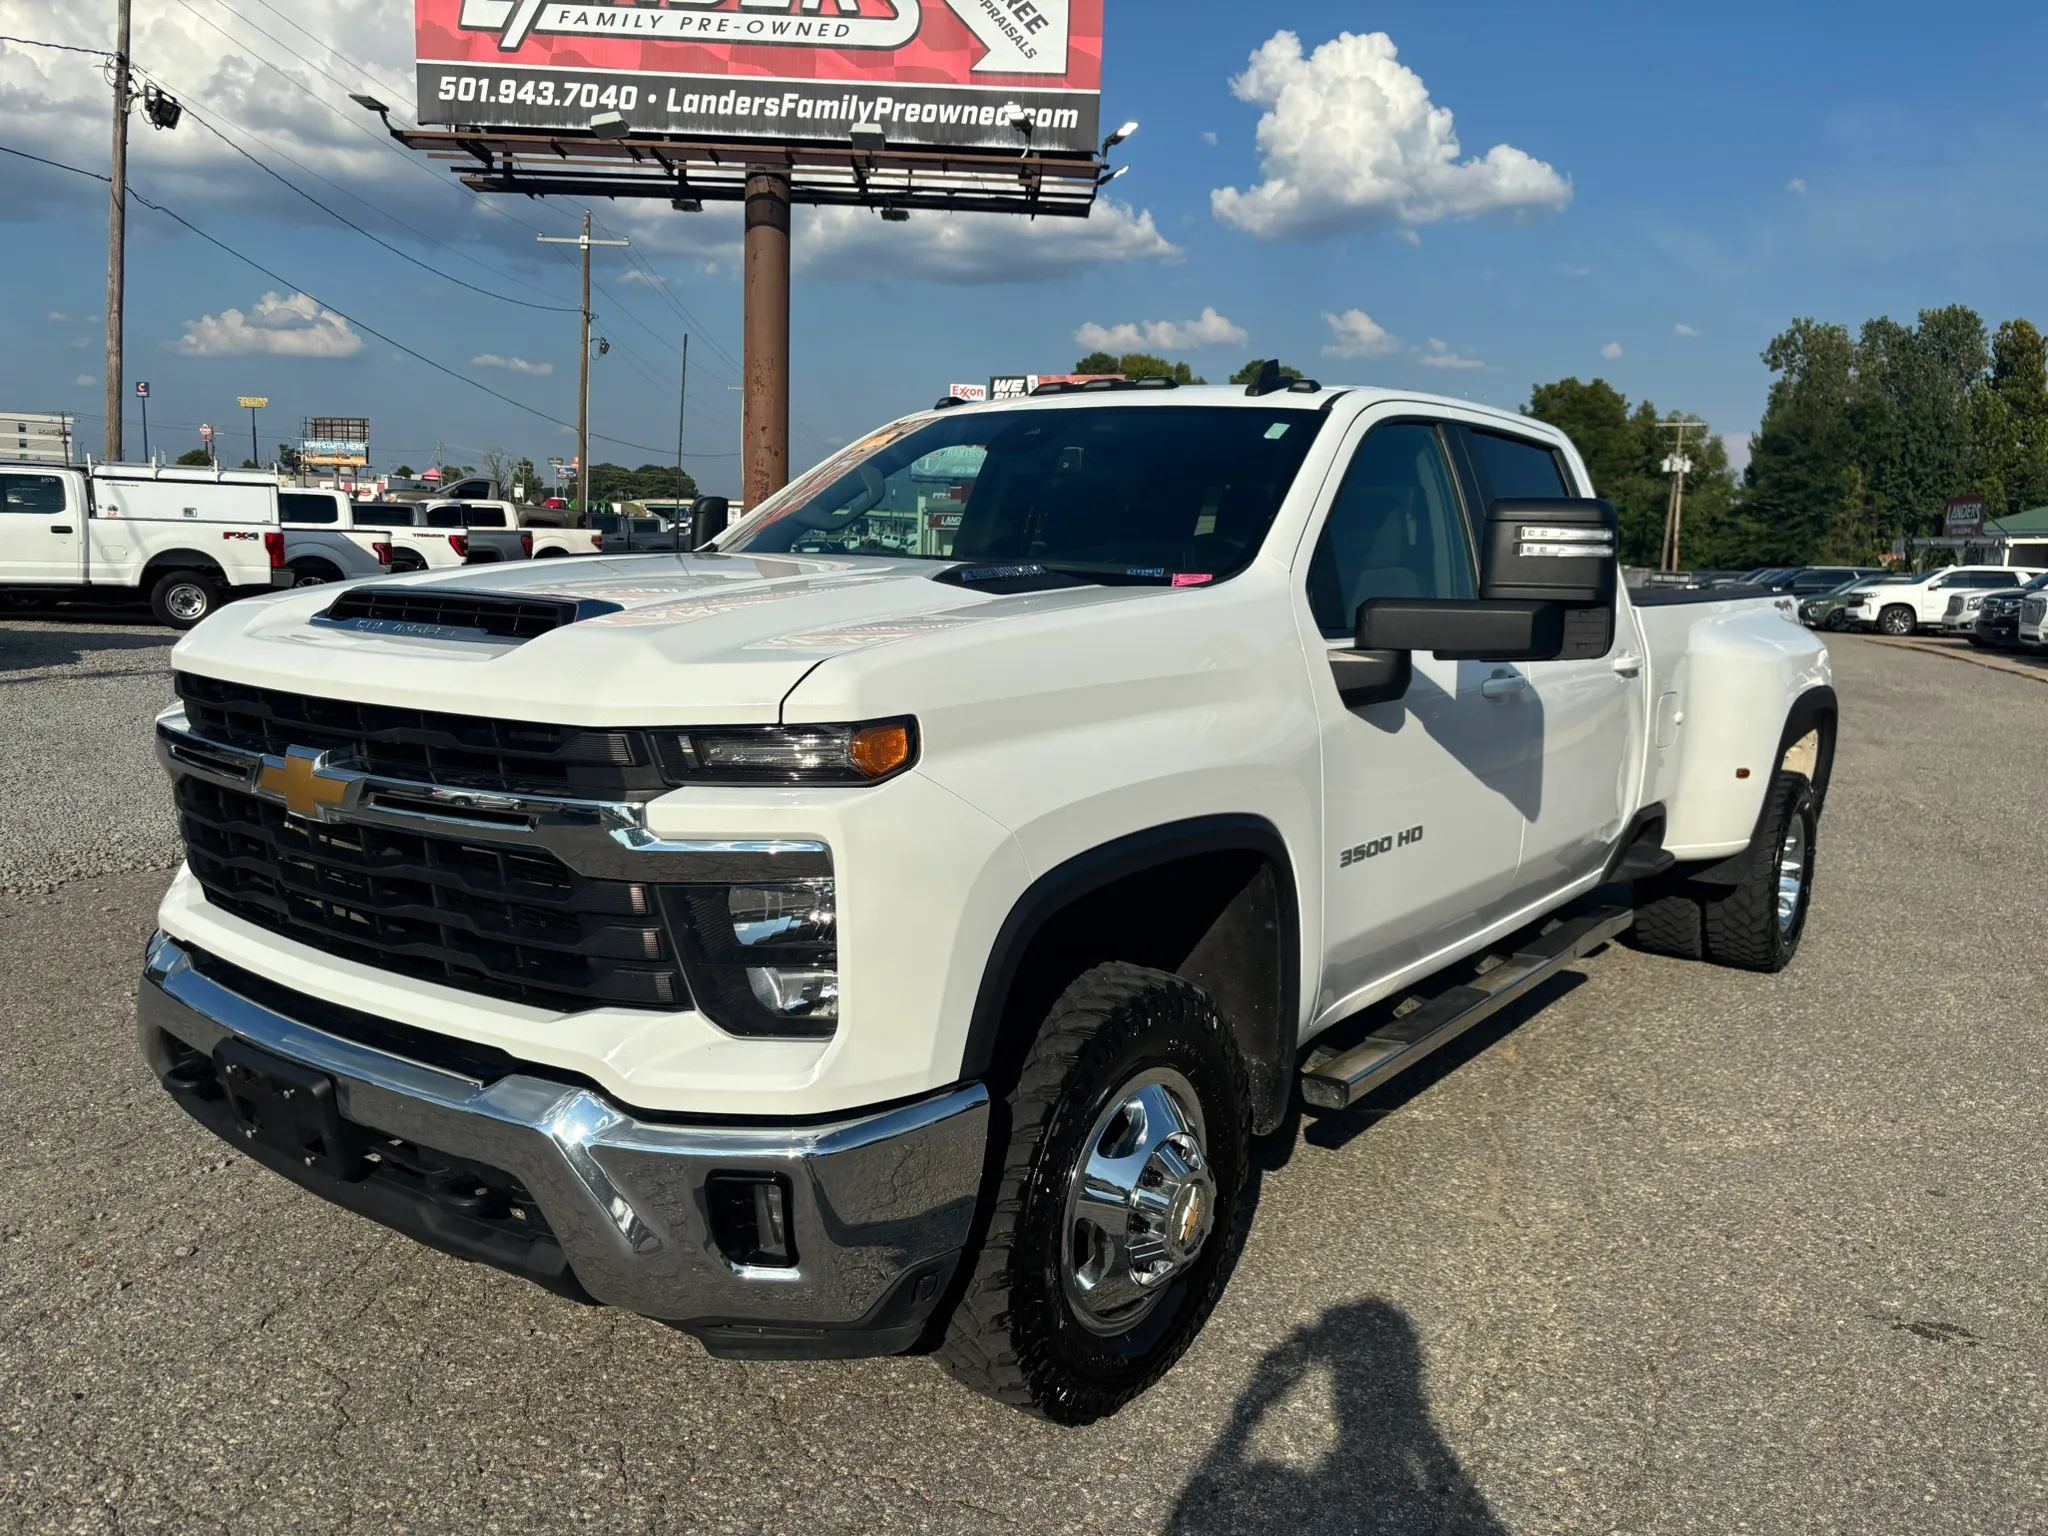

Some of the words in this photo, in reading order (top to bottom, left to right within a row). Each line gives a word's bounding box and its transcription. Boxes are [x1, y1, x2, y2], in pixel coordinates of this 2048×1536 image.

[558, 9, 664, 29] FAMILY
[679, 16, 850, 38] PRE-OWNED
[980, 0, 1038, 59] PRAISALS
[438, 76, 638, 110] 501.943.7040
[666, 87, 1079, 129] LandersFamilyPreownedcom
[952, 386, 984, 399] Exxon
[993, 379, 1025, 392] WE
[1946, 503, 1981, 525] LANDERS
[223, 531, 259, 541] FX4
[1340, 835, 1392, 869] 3500
[1397, 825, 1424, 848] HD
